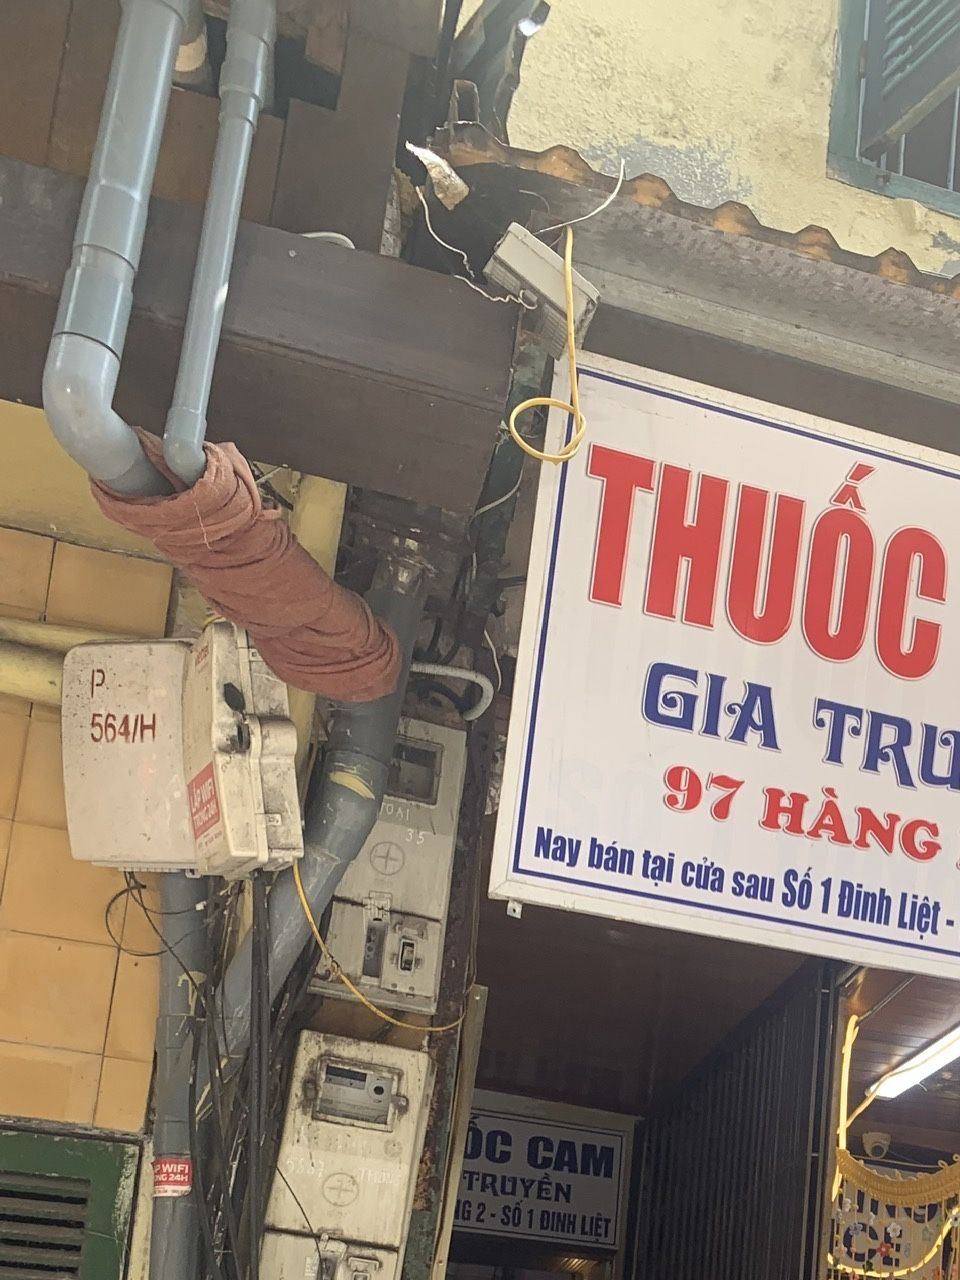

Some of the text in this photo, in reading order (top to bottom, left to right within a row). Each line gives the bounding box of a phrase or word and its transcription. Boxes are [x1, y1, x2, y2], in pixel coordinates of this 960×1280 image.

[587, 442, 948, 681] THUỐC
[91, 668, 106, 699] P
[90, 712, 156, 744] 564/H
[641, 661, 782, 752] GIA
[662, 764, 745, 822] 97
[758, 786, 942, 863] HÀNG
[534, 826, 582, 868] Nay
[587, 837, 635, 875] bán
[641, 849, 675, 887] tại
[680, 856, 725, 893] cửa
[731, 871, 775, 903] sau
[781, 866, 813, 911] Số
[820, 877, 833, 914] 1
[897, 891, 941, 941] Liệt
[161, 1163, 189, 1174] WIFI
[168, 1173, 189, 1182] 24H
[526, 1135, 615, 1180] CAM
[462, 1169, 572, 1204] TRUYỀN
[475, 1202, 486, 1223] 2
[500, 1198, 523, 1228] SỐ
[527, 1208, 535, 1229] 1
[580, 1212, 612, 1243] LIỆT
